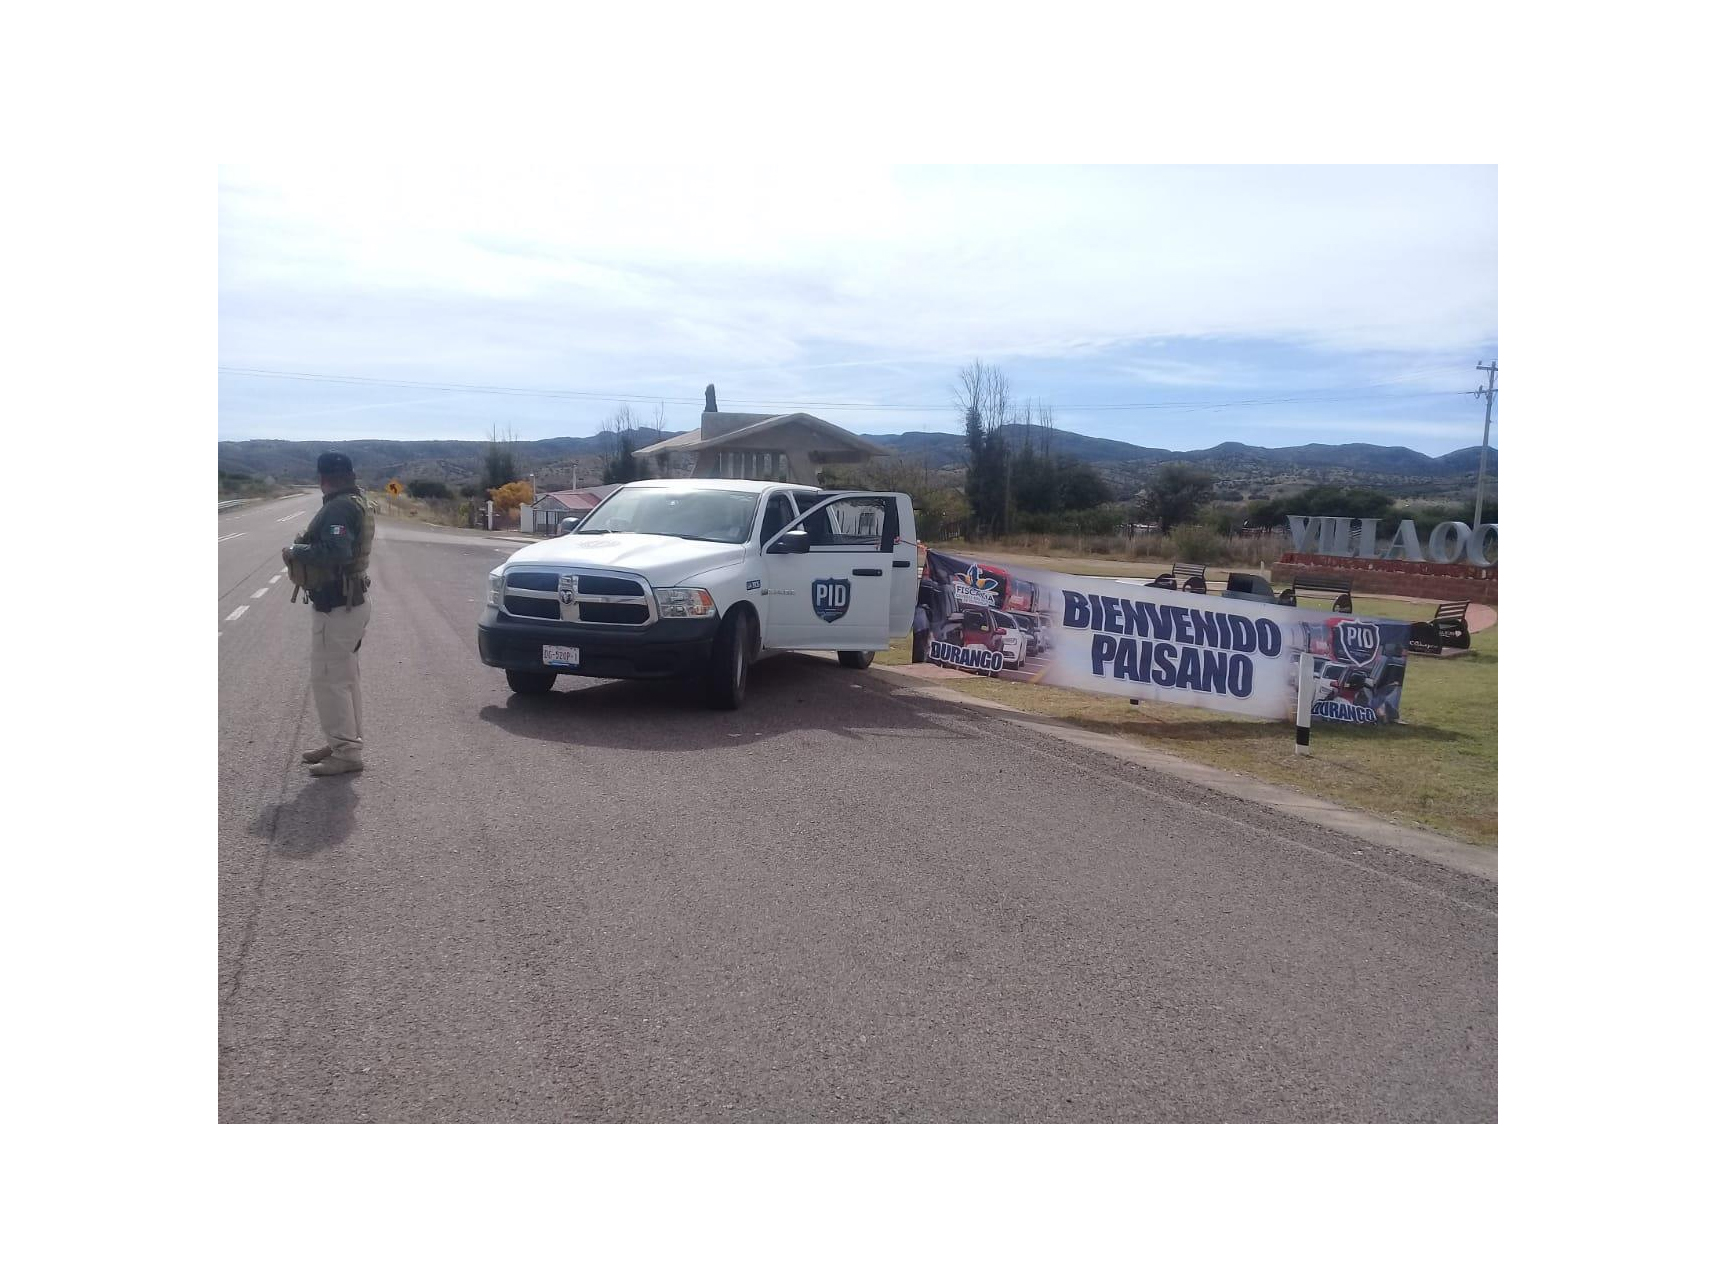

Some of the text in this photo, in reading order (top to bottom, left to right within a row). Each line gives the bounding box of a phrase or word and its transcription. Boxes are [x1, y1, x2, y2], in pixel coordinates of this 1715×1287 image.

[816, 584, 846, 607] PID
[1062, 590, 1282, 657] BIENVENIDO
[931, 641, 1003, 670] DURANGO
[1091, 633, 1254, 698] PAISANO
